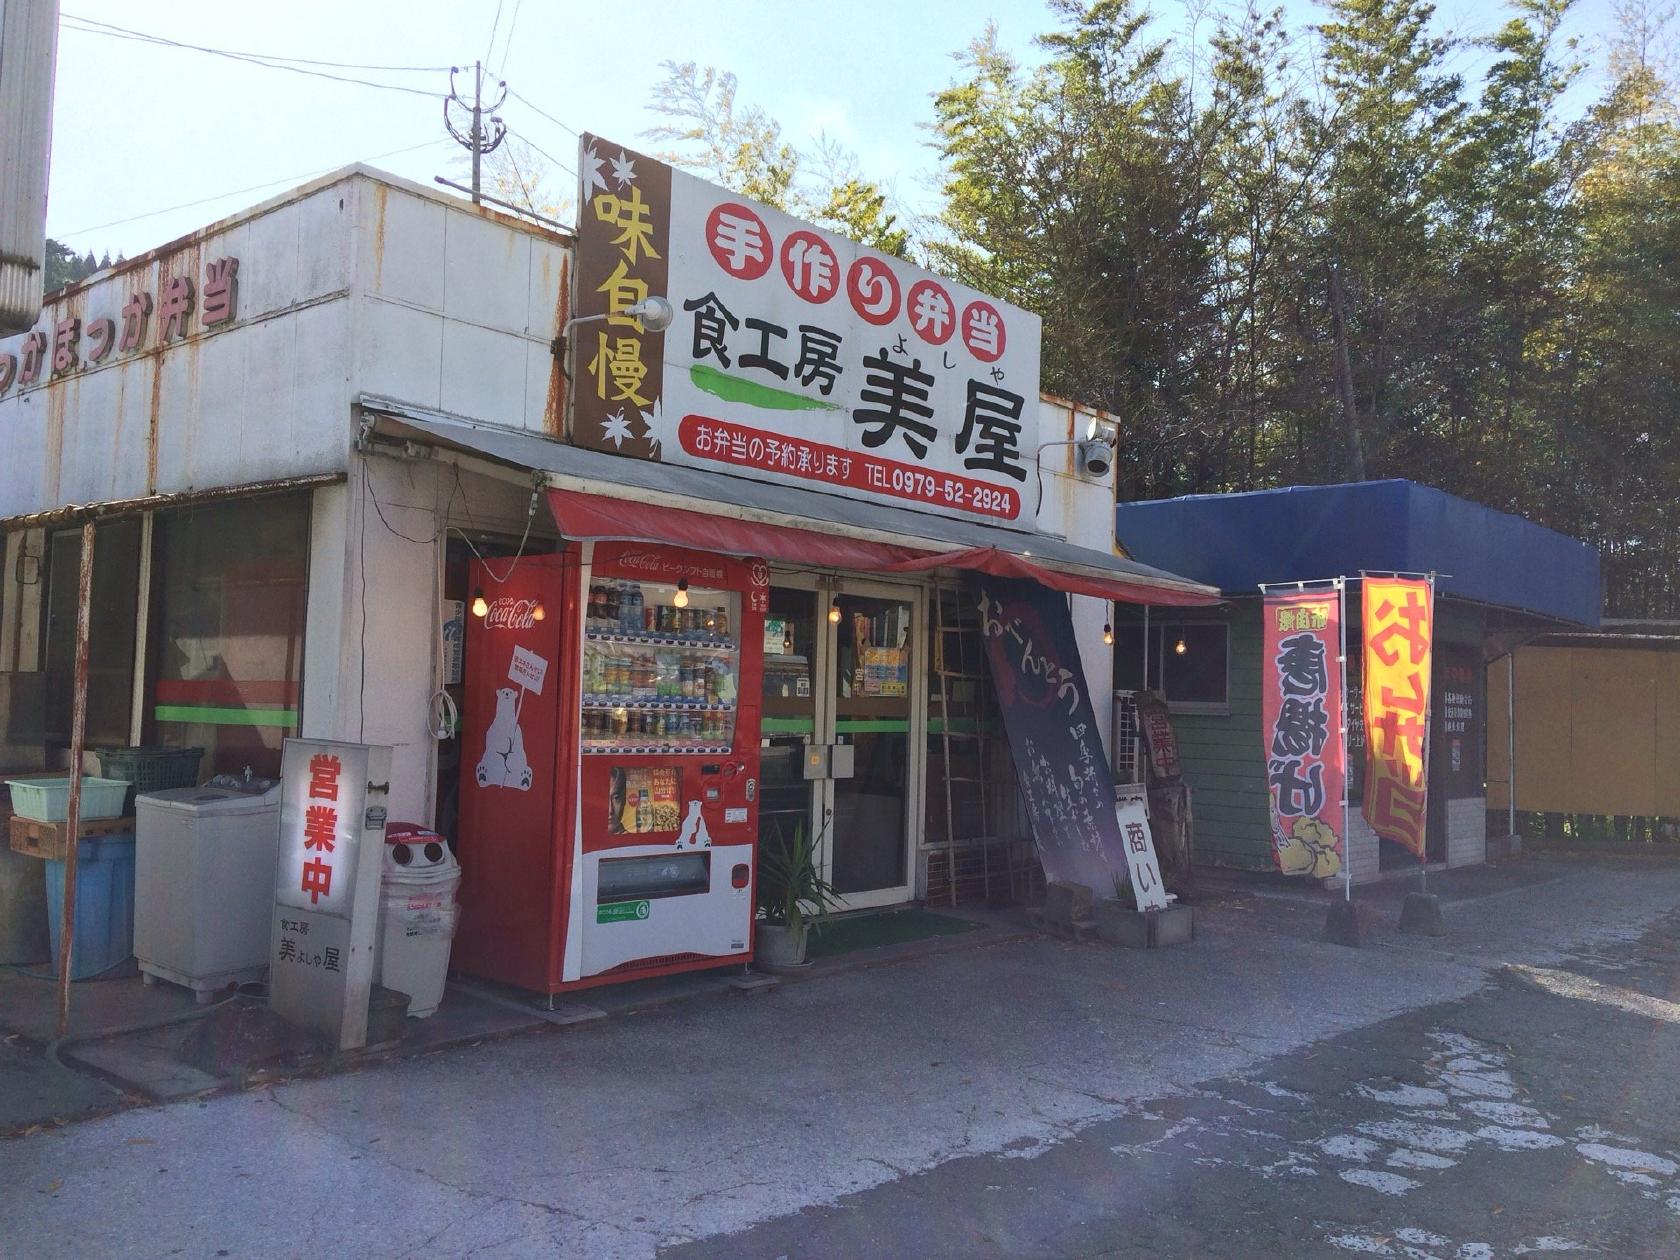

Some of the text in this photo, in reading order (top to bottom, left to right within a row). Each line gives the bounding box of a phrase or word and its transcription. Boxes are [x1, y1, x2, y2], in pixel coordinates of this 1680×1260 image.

[587, 185, 662, 407] 味自慢
[712, 211, 1001, 358] 手作り弁当
[684, 292, 843, 396] 食工房
[893, 334, 1005, 386] よしや
[852, 347, 1028, 483] 美屋
[695, 425, 1011, 514] お弁当の予約承ります TEL 0979-52-2924
[484, 599, 538, 630] Coca-Cola
[977, 586, 1080, 716] おべんとう
[1150, 713, 1175, 768] 営業中
[301, 752, 342, 904] 営業中
[279, 918, 311, 936] 食工房
